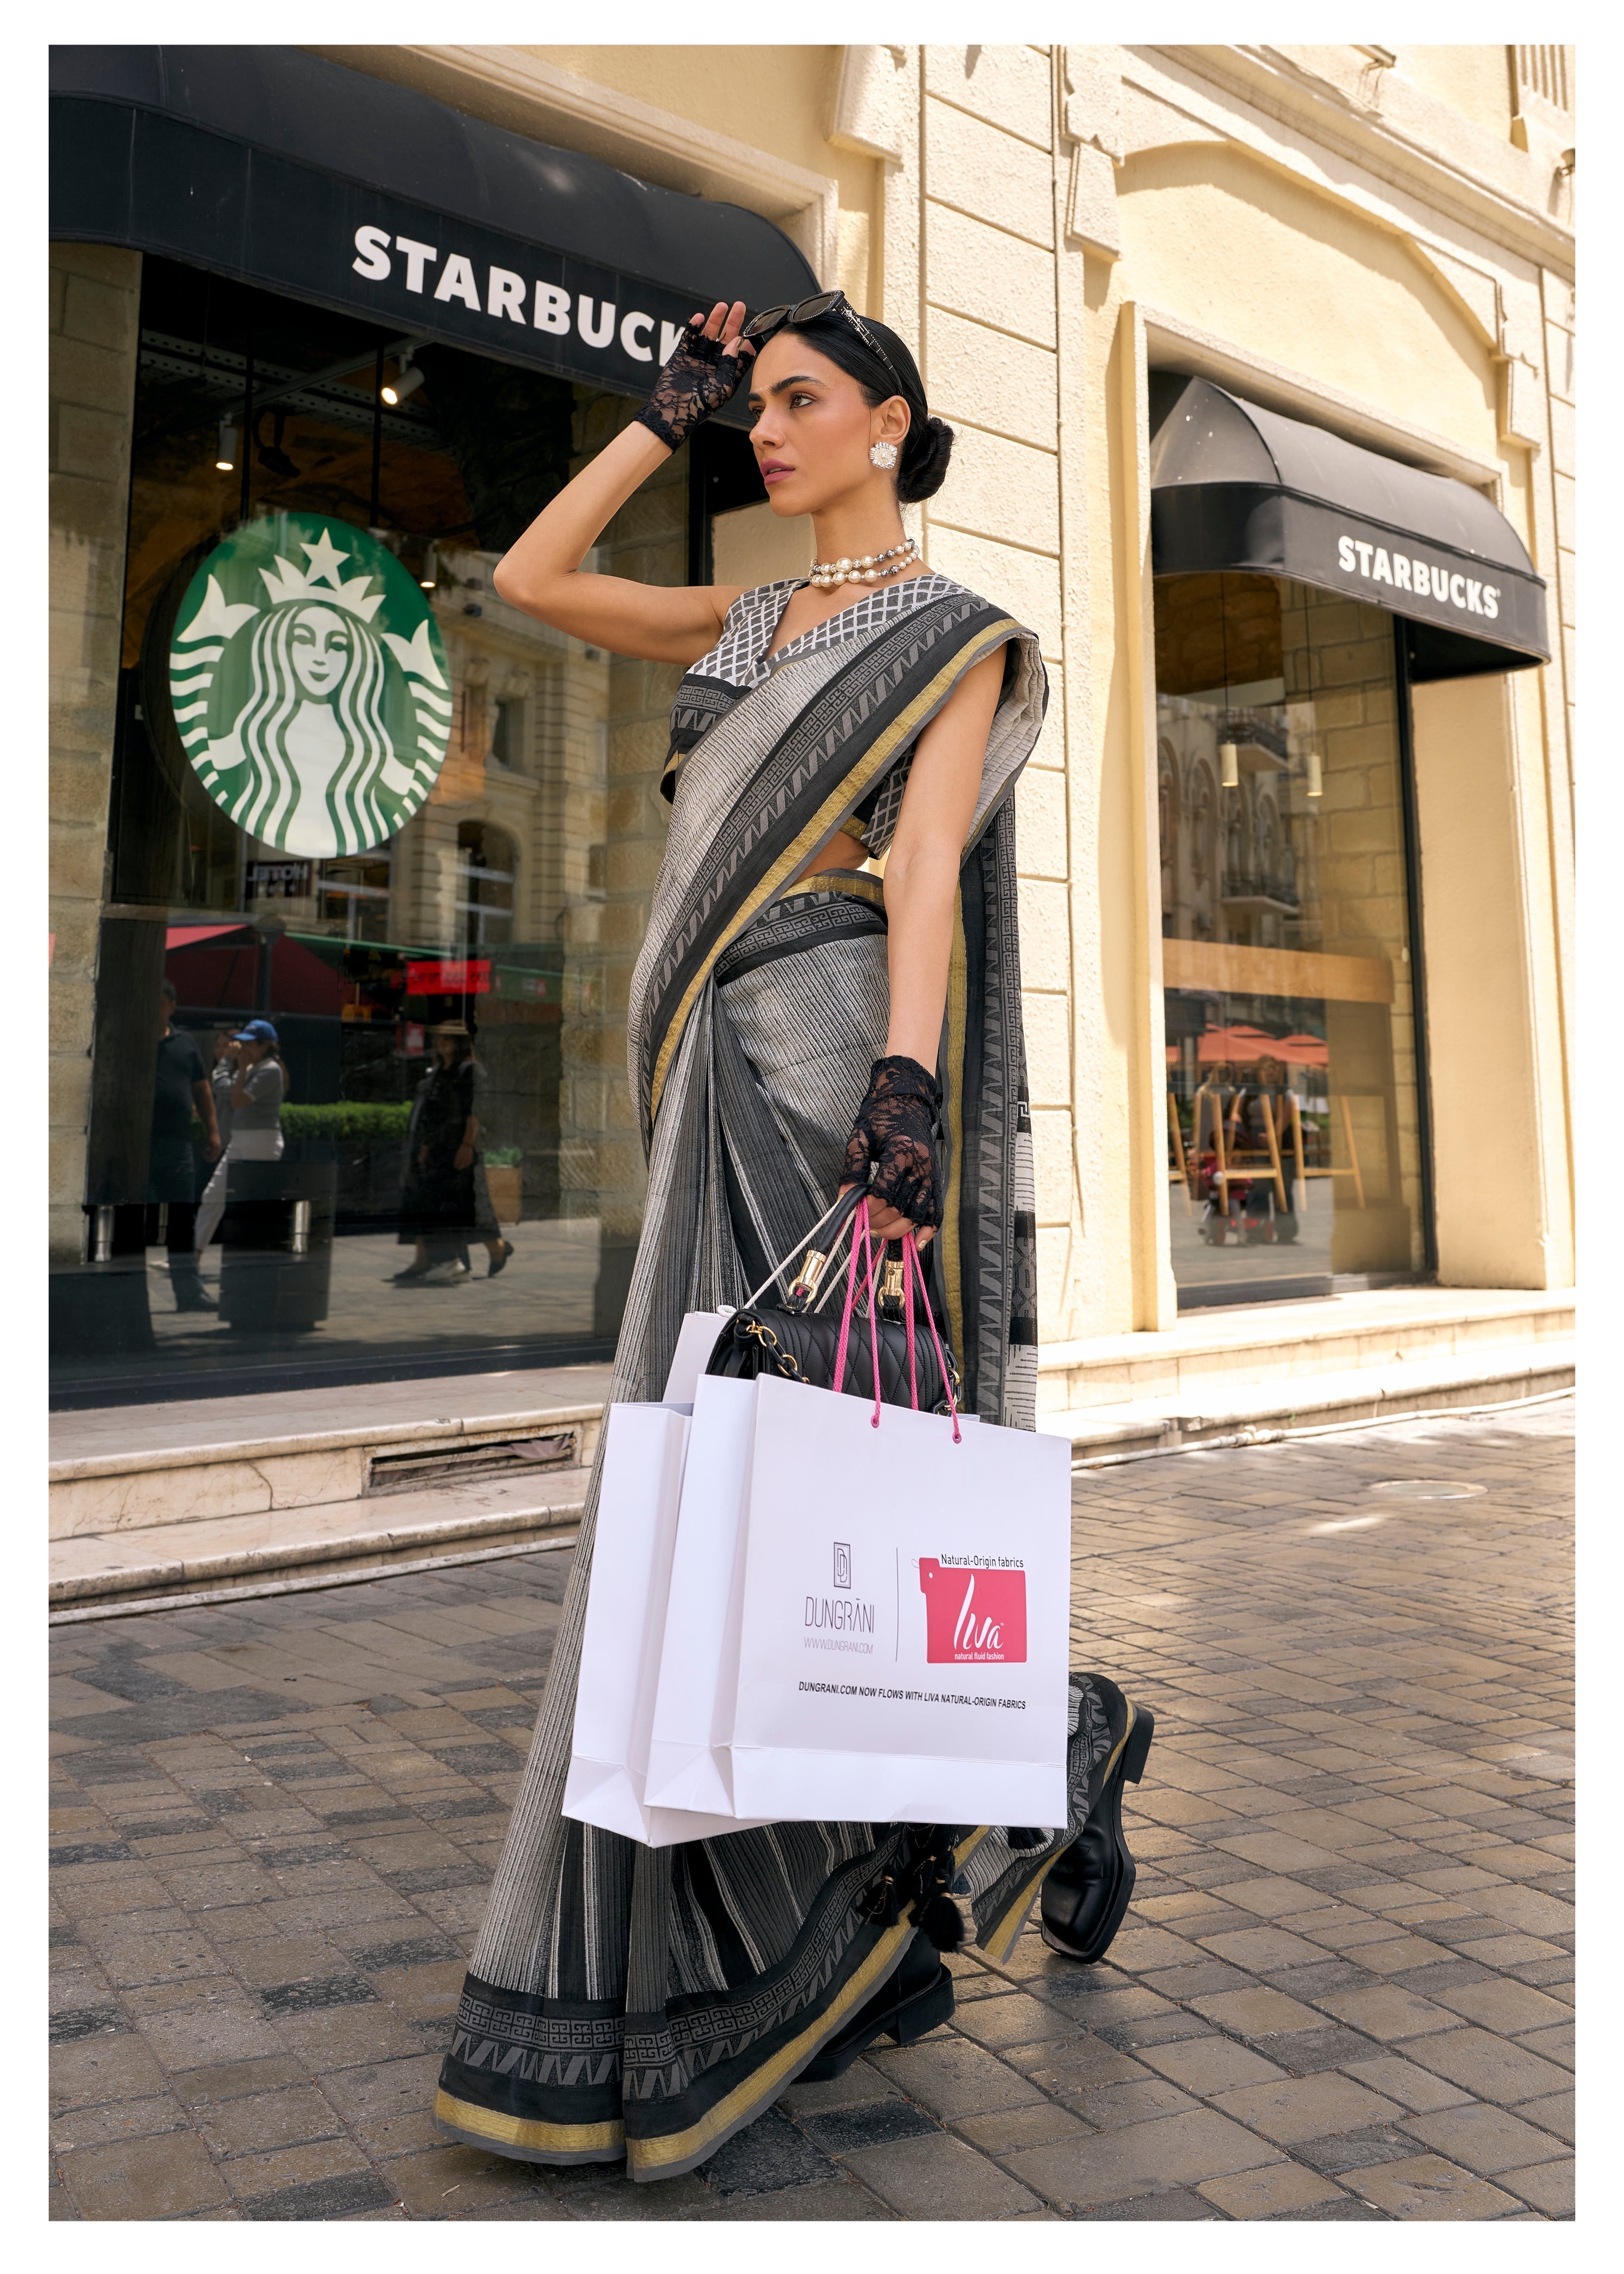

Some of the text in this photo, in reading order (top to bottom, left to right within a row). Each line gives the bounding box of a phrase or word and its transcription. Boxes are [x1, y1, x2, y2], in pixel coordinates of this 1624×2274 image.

[351, 225, 686, 367] STARBUCK
[1338, 535, 1499, 619] STARBUCKS
[941, 1553, 1024, 1569] Natural-Origin fabrics
[804, 1637, 873, 1654] WWW.DUNGRANI.COM
[954, 1652, 1004, 1660] natural fluid fashion
[798, 1681, 1026, 1709] DUNGRANI.COM NOW FLOWS WITH LIVA NATURAL-ORIGIN FABRICS
